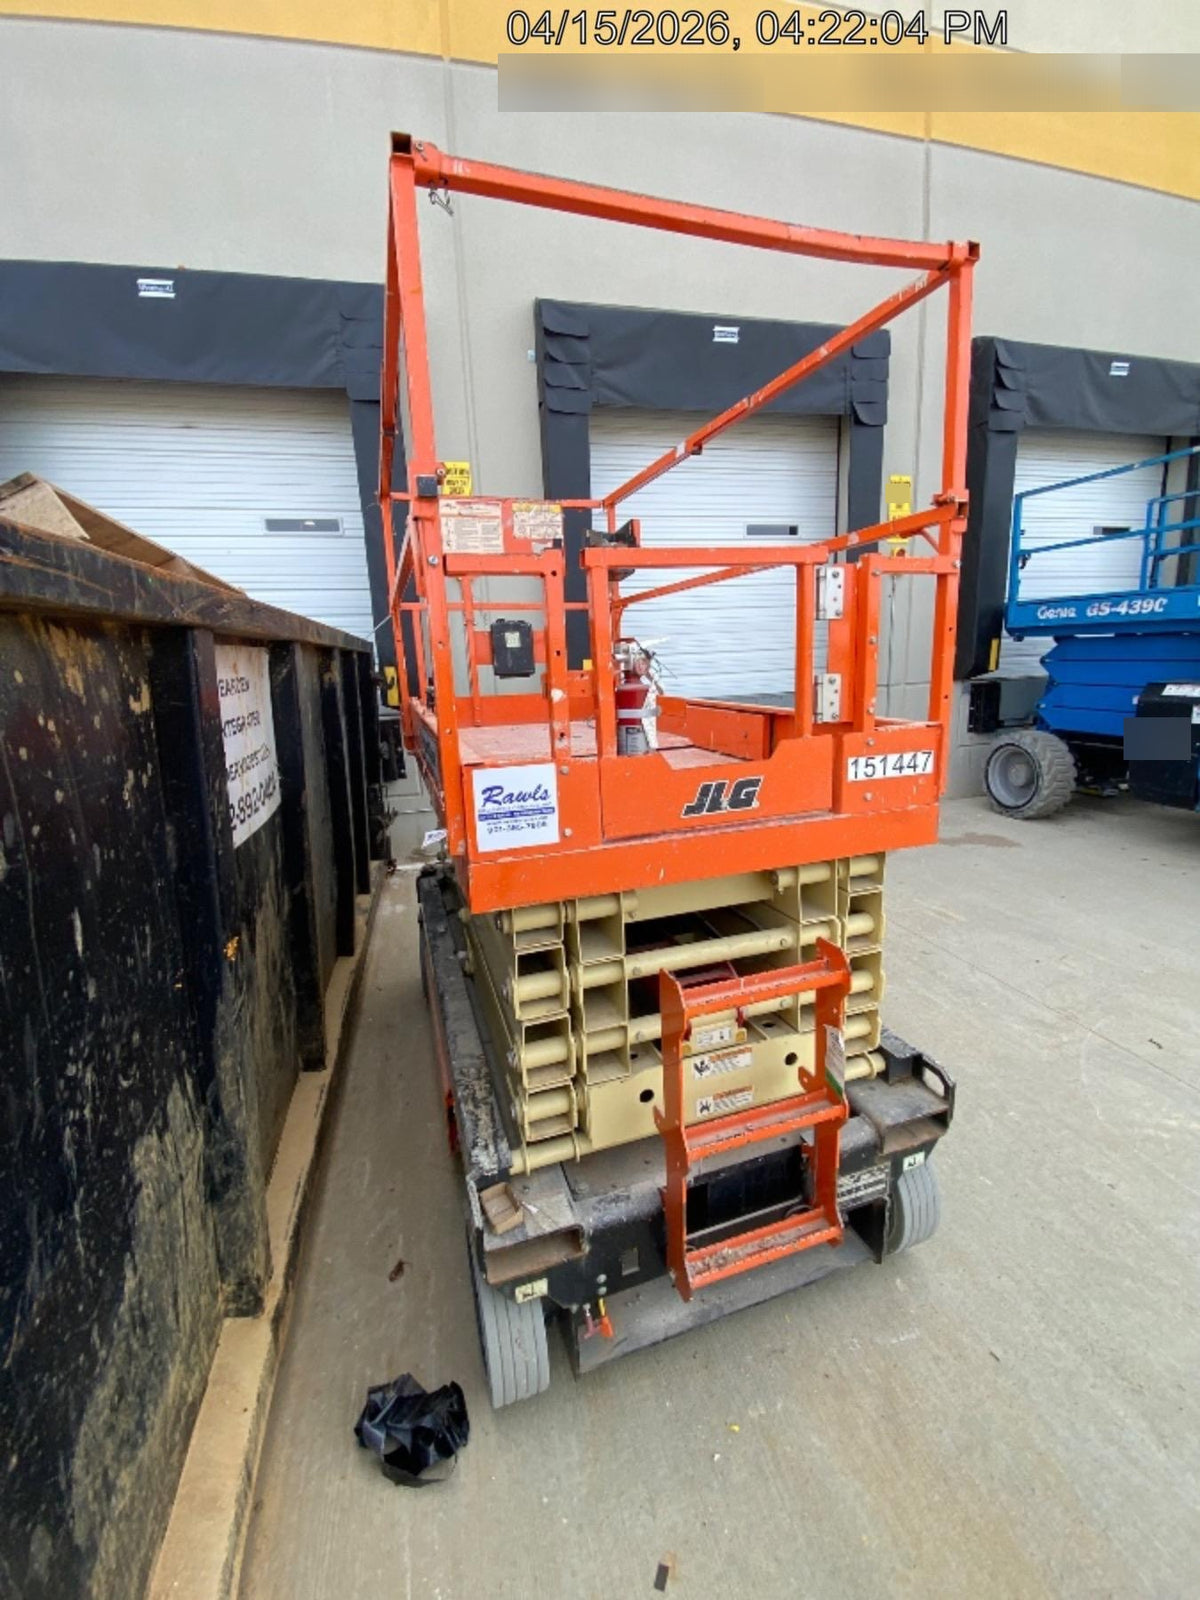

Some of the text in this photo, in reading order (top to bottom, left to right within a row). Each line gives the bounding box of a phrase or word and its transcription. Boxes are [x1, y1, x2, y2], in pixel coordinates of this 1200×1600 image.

[1036, 606, 1078, 620] Genie
[849, 751, 933, 779] 151447
[481, 783, 551, 808] Rawls
[681, 776, 764, 819] JLG
